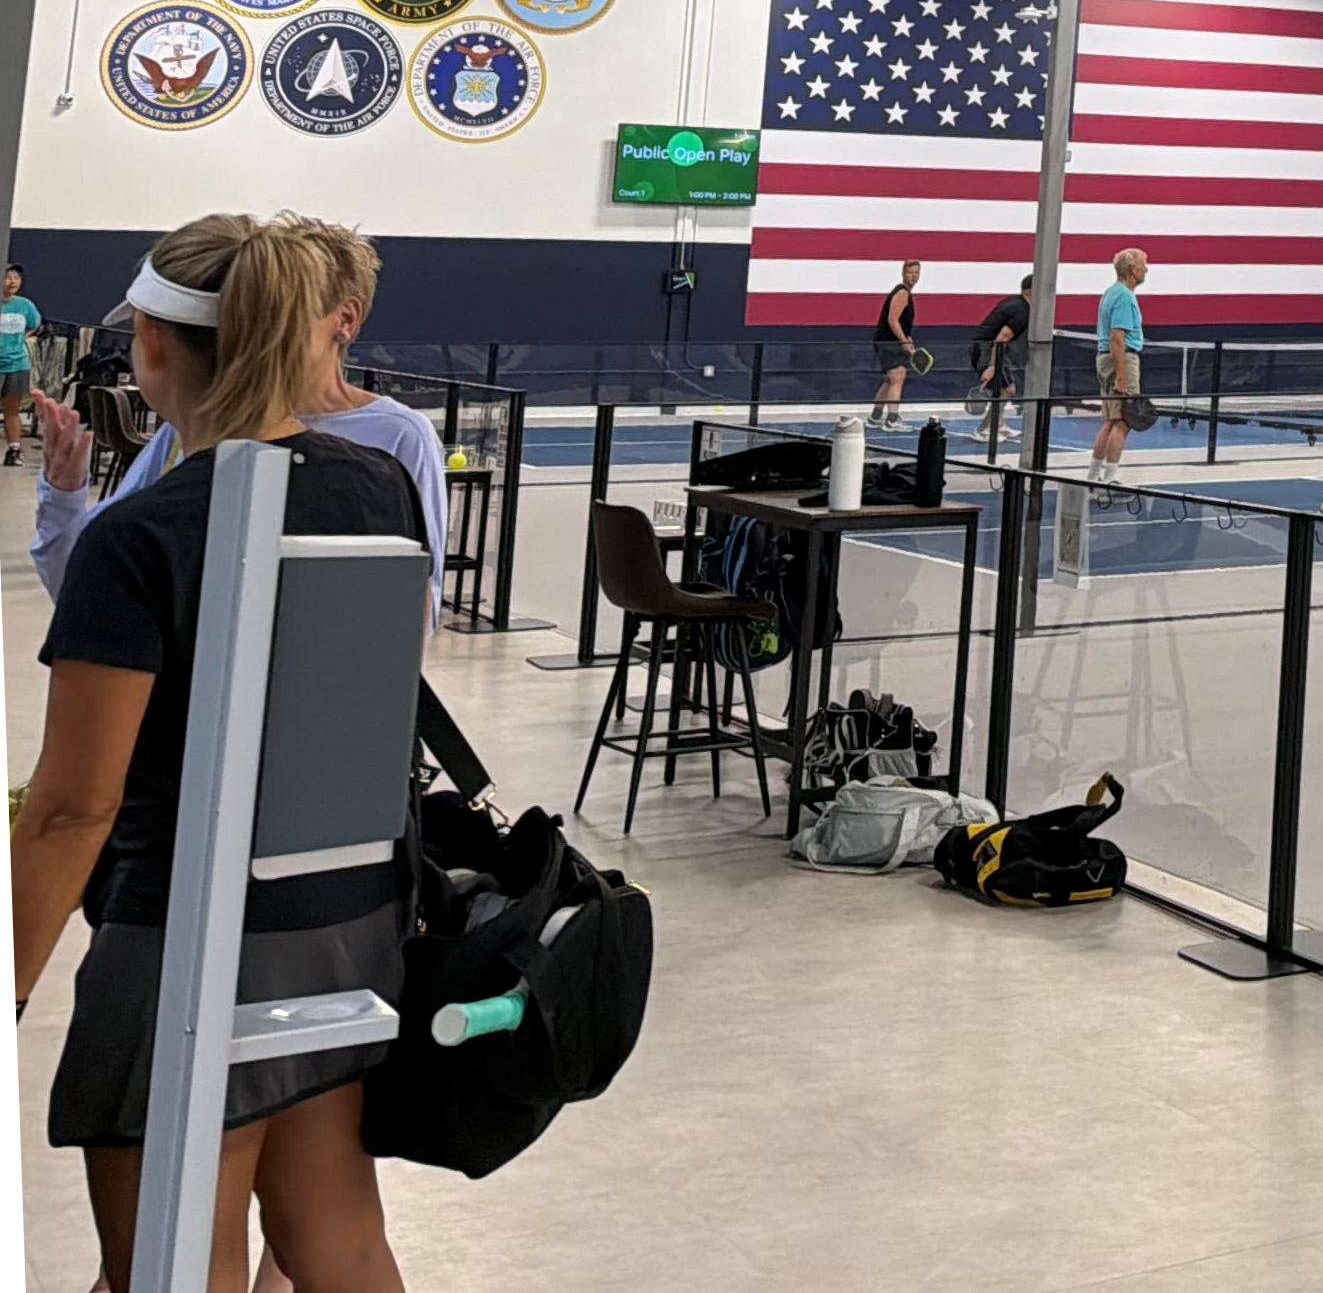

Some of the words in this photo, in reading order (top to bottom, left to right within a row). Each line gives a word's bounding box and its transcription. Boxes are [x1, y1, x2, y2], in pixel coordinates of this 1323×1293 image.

[116, 9, 182, 56] DEPARTMENT
[185, 11, 203, 22] OF
[206, 17, 228, 35] THE
[224, 32, 243, 61] NAVY
[387, 4, 438, 17] ARMY
[264, 23, 298, 65] UNITED
[297, 12, 344, 30] STATES
[345, 10, 382, 39] SPACE
[378, 35, 400, 71] FORCE
[412, 27, 455, 97] DEPARTMENT
[461, 22, 481, 32] OF
[488, 22, 514, 39] THE
[515, 40, 535, 60] AIR
[111, 67, 138, 105] UNITED
[134, 102, 178, 121] STATES
[180, 109, 198, 120] OF
[201, 76, 240, 115] AMERICA
[264, 80, 314, 131] DEPARTMENT
[314, 123, 330, 133] OF
[333, 119, 356, 133] THE
[357, 112, 375, 128] AIR
[372, 85, 397, 117] FORCE
[622, 144, 670, 159] Public
[674, 146, 716, 163] Open
[719, 148, 751, 166] Play
[618, 188, 640, 197] Court
